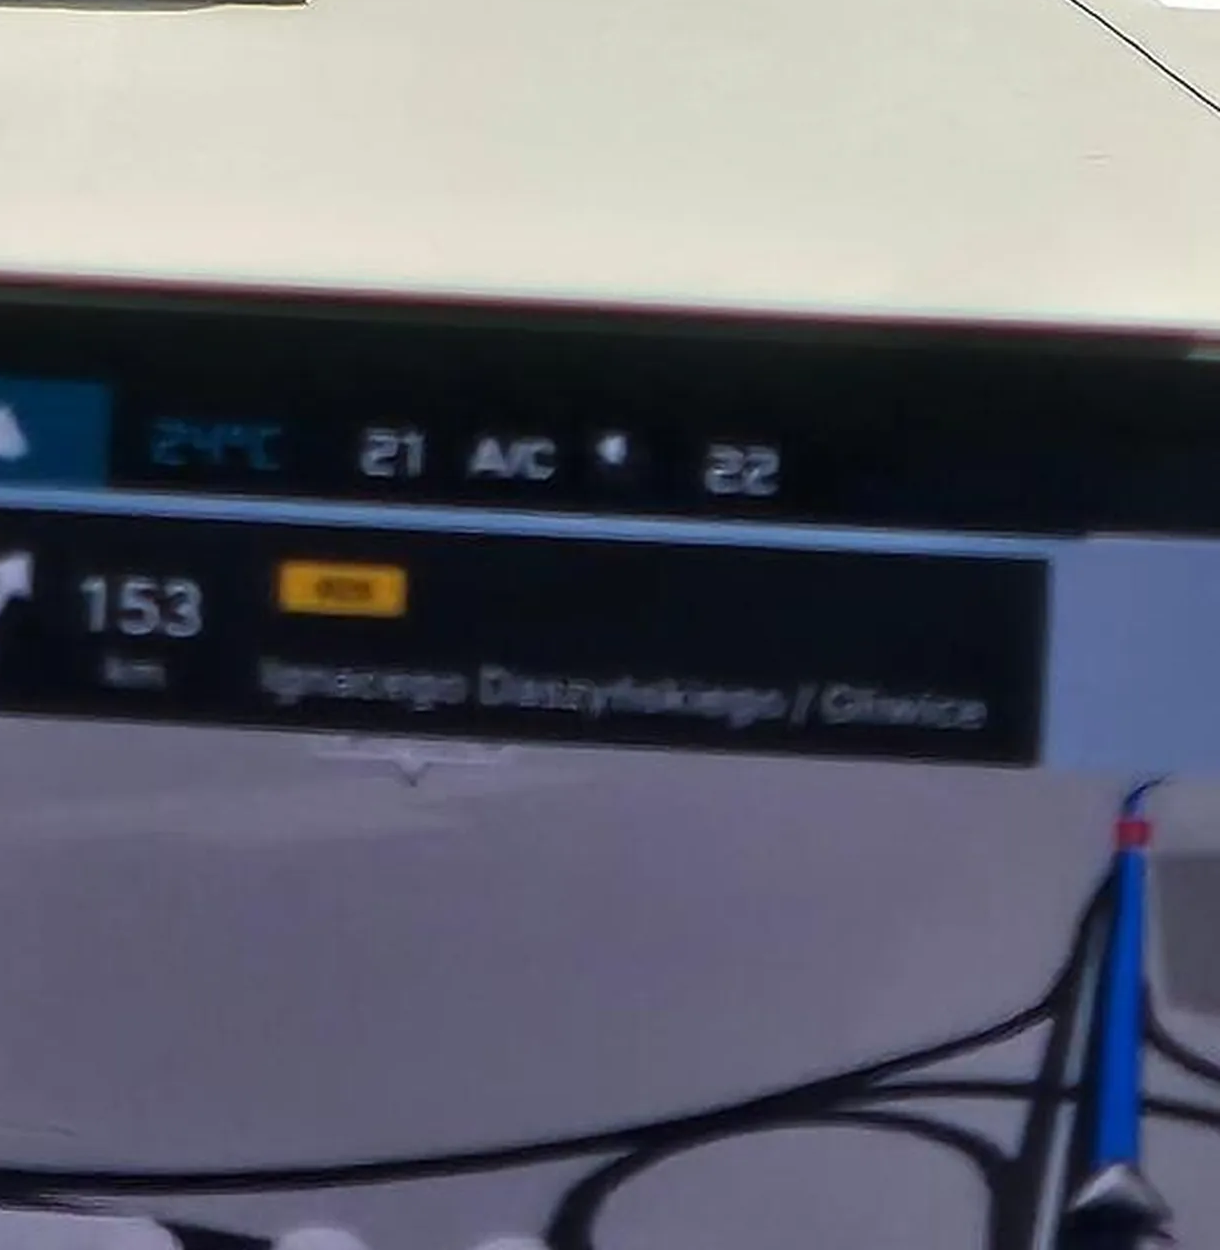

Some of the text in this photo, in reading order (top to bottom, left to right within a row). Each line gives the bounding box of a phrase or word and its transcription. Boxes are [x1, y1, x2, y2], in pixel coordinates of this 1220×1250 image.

[360, 427, 426, 478] 21
[467, 437, 556, 481] A/C
[704, 445, 779, 496] 22
[80, 576, 204, 638] 153
[821, 682, 988, 731] Gliwice
